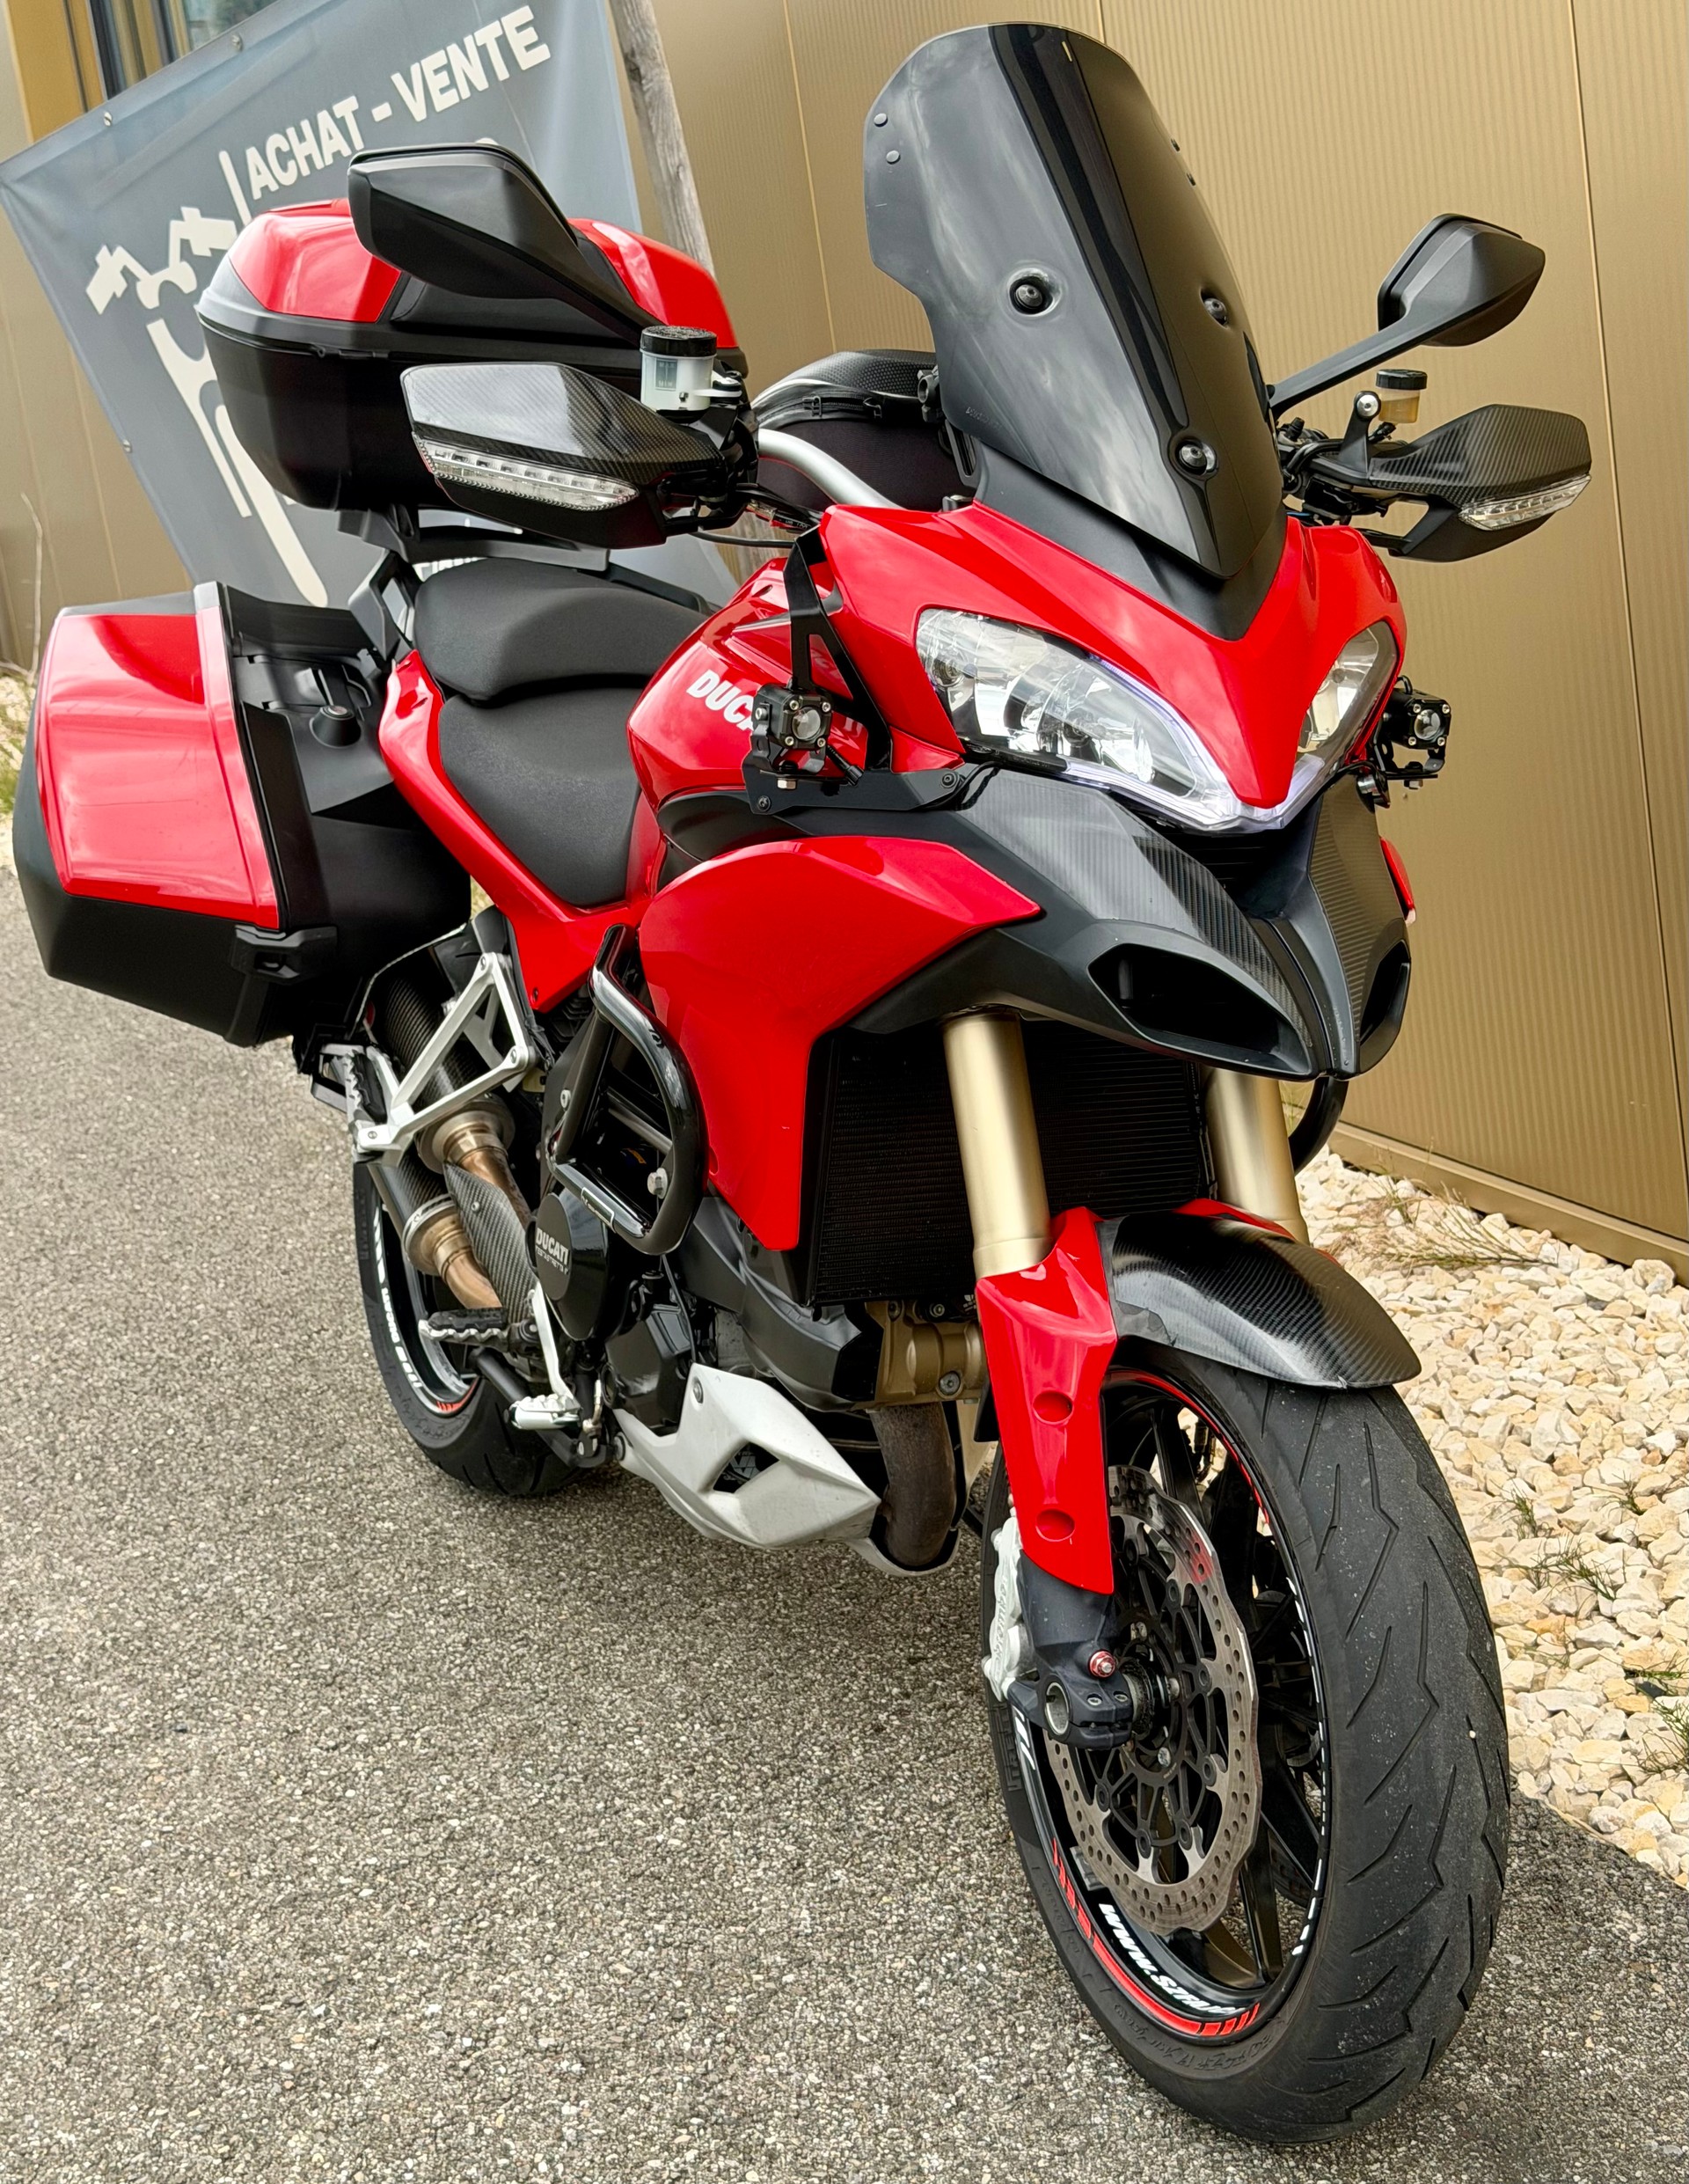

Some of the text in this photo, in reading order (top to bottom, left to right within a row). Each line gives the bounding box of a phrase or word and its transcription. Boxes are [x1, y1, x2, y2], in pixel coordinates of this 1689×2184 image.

[245, 95, 365, 200] ACHAT
[391, 5, 552, 122] VENTE
[536, 1228, 569, 1265] DUCATI
